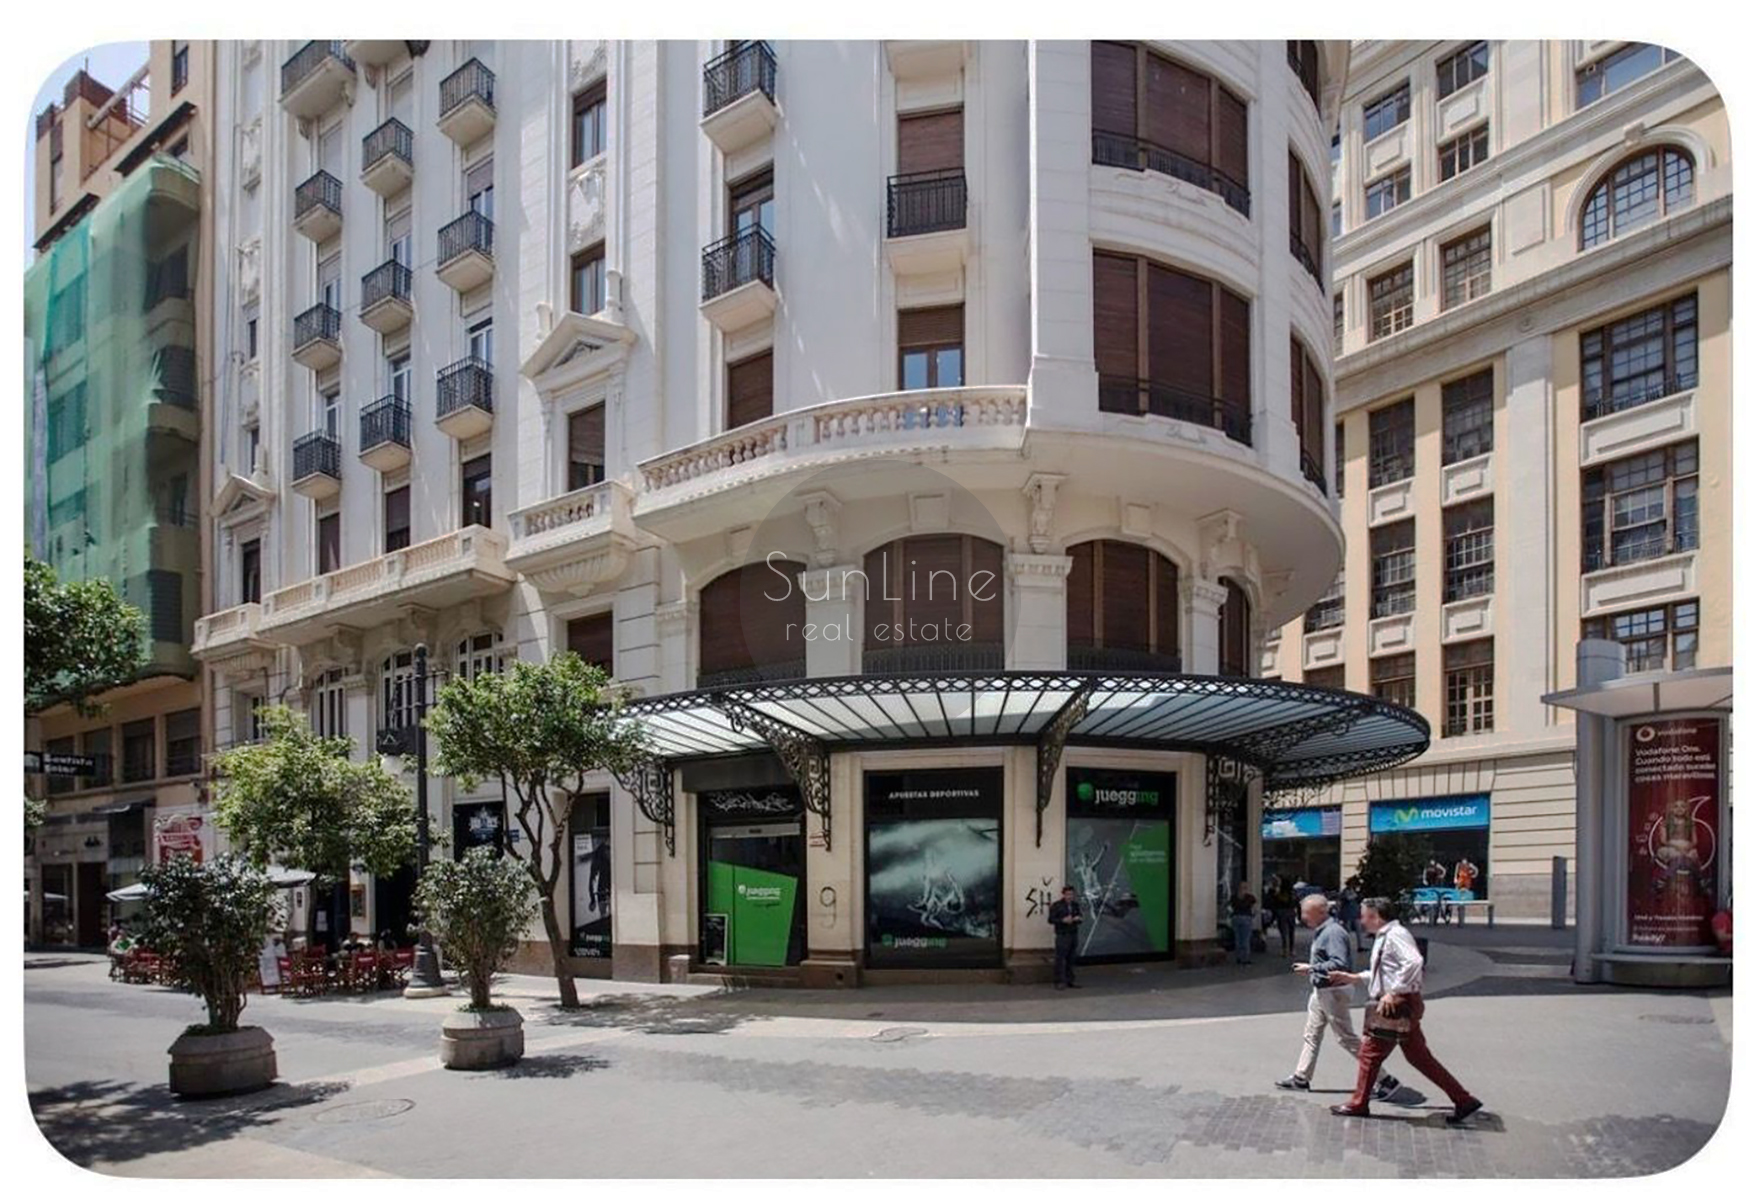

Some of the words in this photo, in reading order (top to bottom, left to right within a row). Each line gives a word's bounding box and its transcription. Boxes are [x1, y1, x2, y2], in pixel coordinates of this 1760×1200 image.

[888, 790, 928, 799] APUESTAS
[929, 789, 979, 798] DEPORTIVAS
[1095, 789, 1159, 805] juegging
[1421, 806, 1477, 819] movistar
